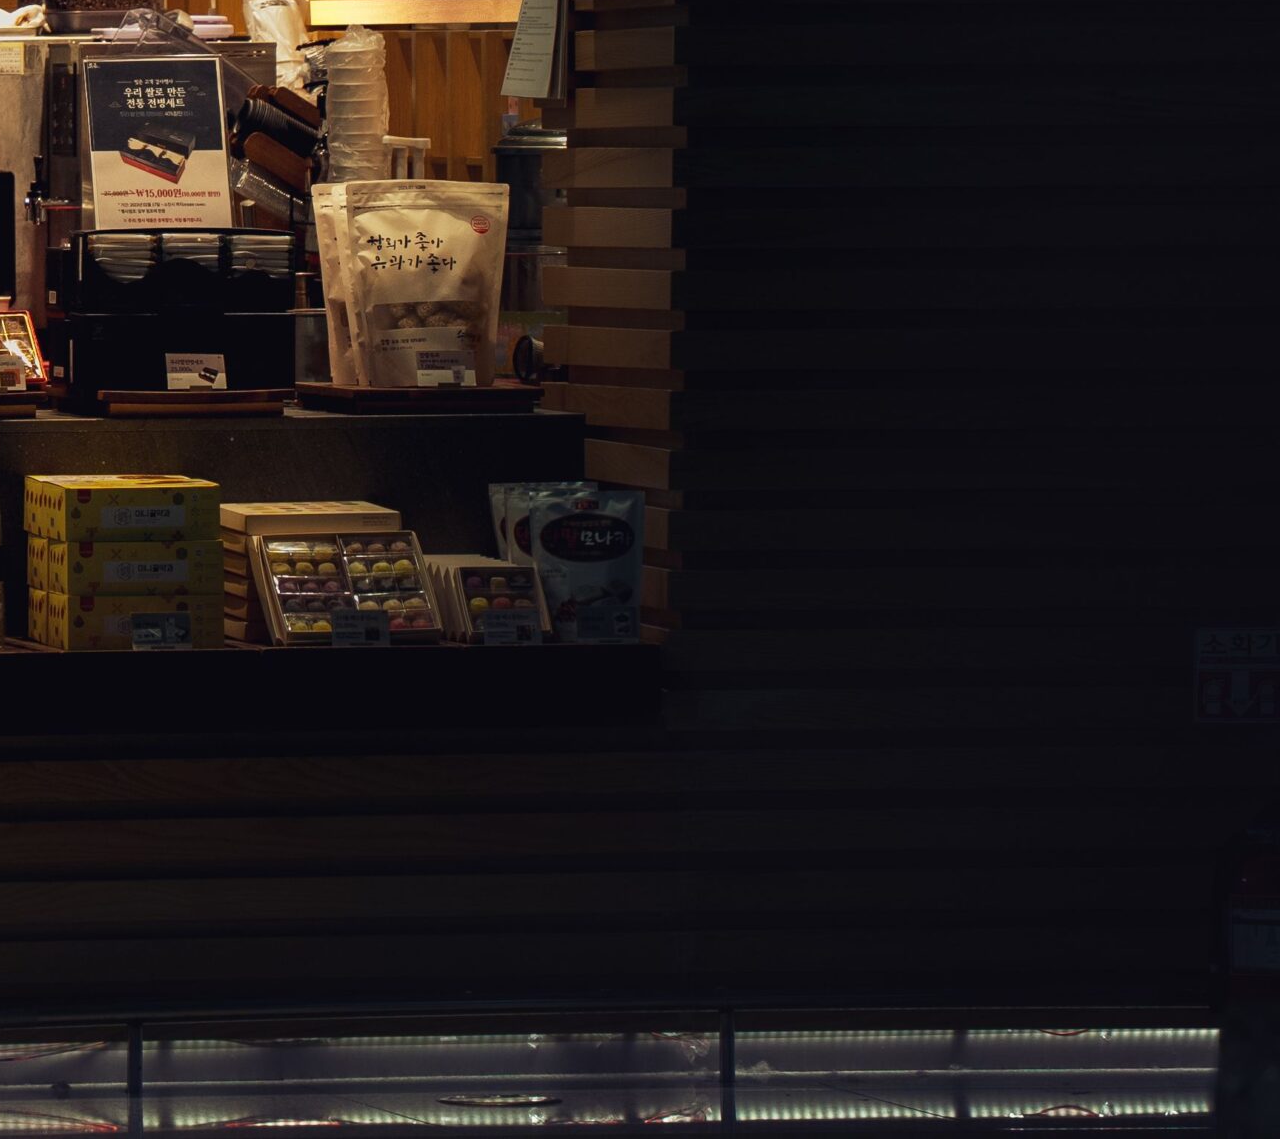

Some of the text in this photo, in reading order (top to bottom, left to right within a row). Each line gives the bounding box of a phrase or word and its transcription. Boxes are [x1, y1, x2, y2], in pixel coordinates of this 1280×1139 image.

[123, 87, 187, 98] 우리 쌀로 만든
[126, 98, 145, 109] 전통
